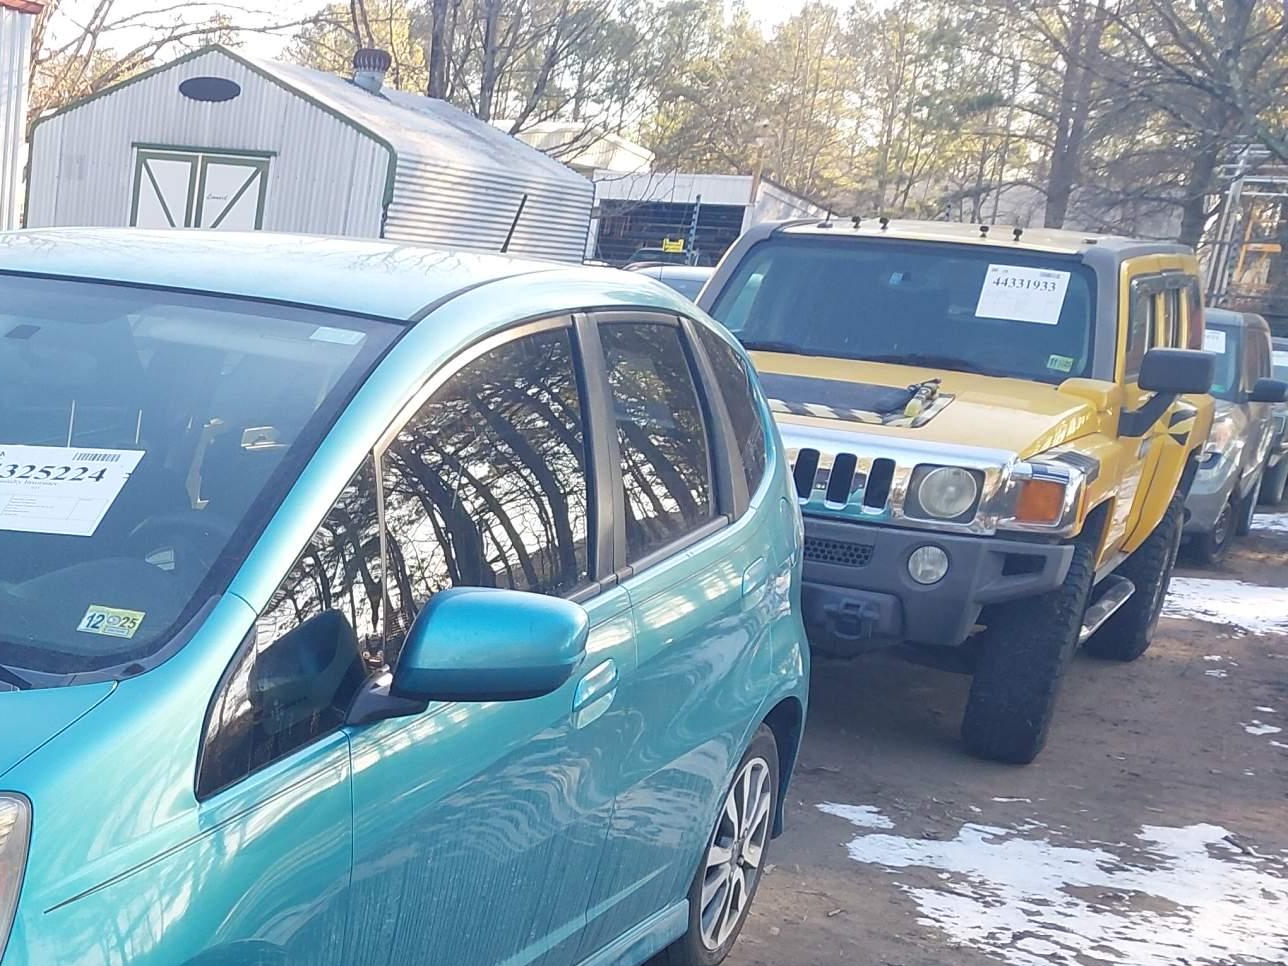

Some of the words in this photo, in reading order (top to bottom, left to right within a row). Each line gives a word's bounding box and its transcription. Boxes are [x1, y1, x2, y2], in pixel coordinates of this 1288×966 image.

[992, 276, 1057, 292] 44331933
[86, 613, 105, 629] 12
[119, 616, 140, 630] 25
